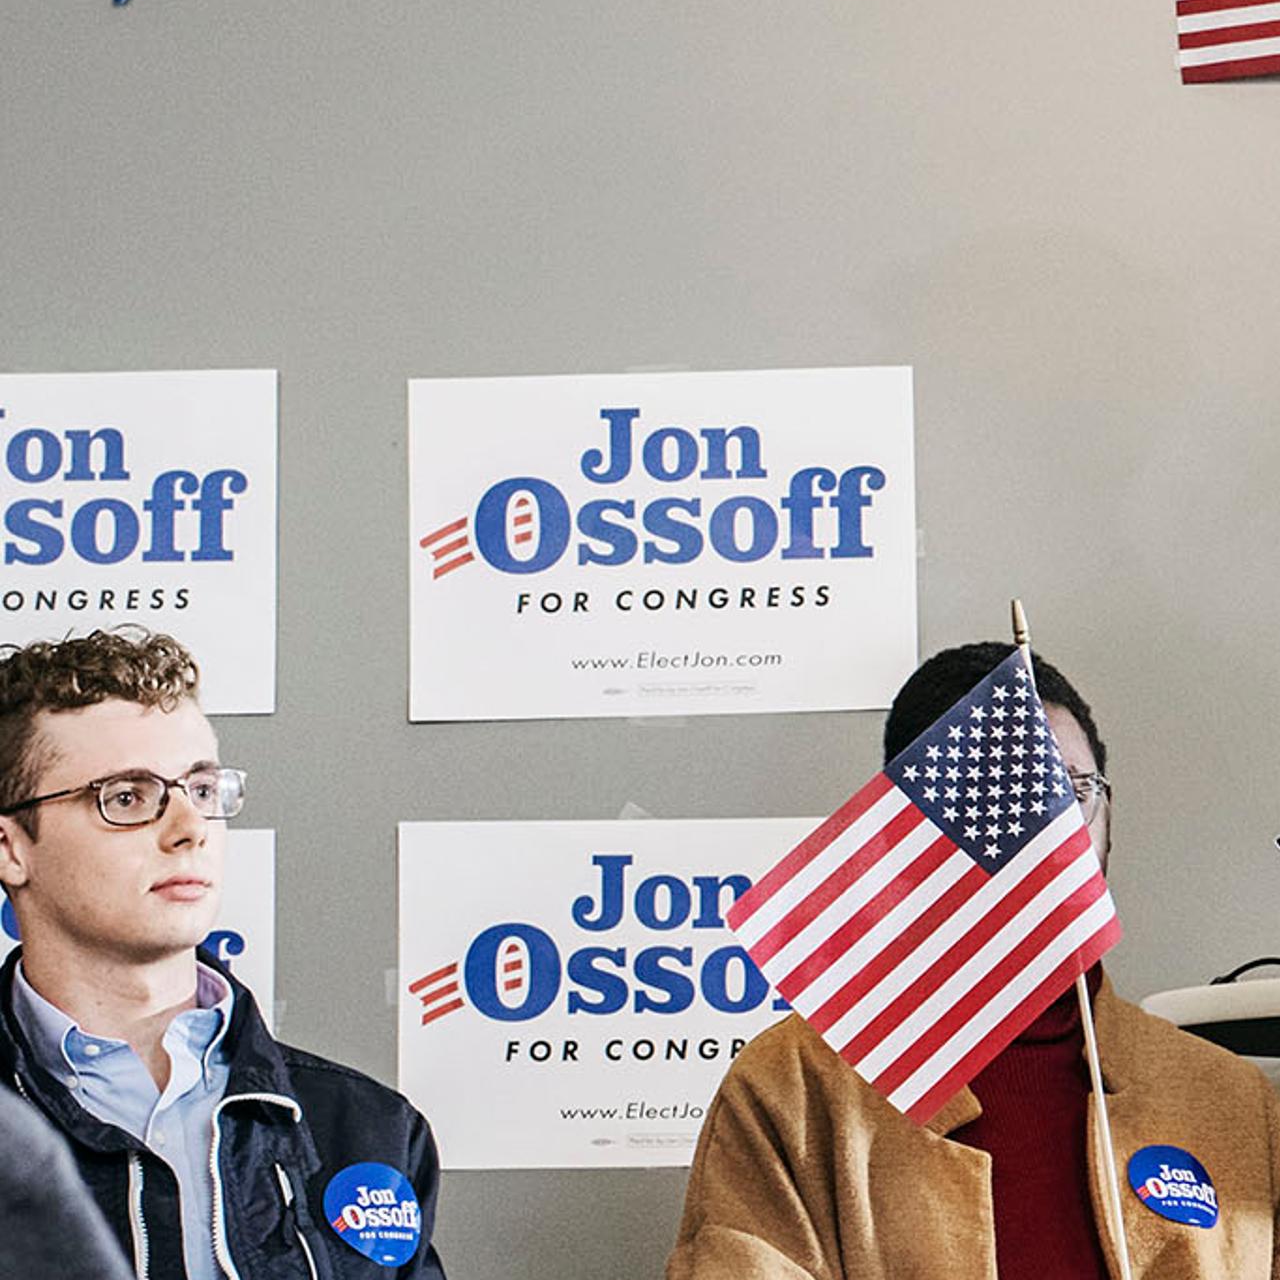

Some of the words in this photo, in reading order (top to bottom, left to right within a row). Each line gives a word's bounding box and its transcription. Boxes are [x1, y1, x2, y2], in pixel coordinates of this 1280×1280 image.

[0, 408, 130, 483] on
[580, 408, 767, 484] Jon
[474, 466, 886, 575] Ossoff
[517, 592, 590, 614] FOR
[615, 585, 833, 611] CONGRESS
[571, 651, 783, 669] www.ElectJon.com
[464, 923, 793, 1023] Osso
[505, 1040, 580, 1062] FOR
[1159, 1164, 1197, 1184] Jon
[356, 1186, 398, 1207] Jon
[1145, 1177, 1218, 1209] Ossoff
[342, 1200, 418, 1230] Ossoff
